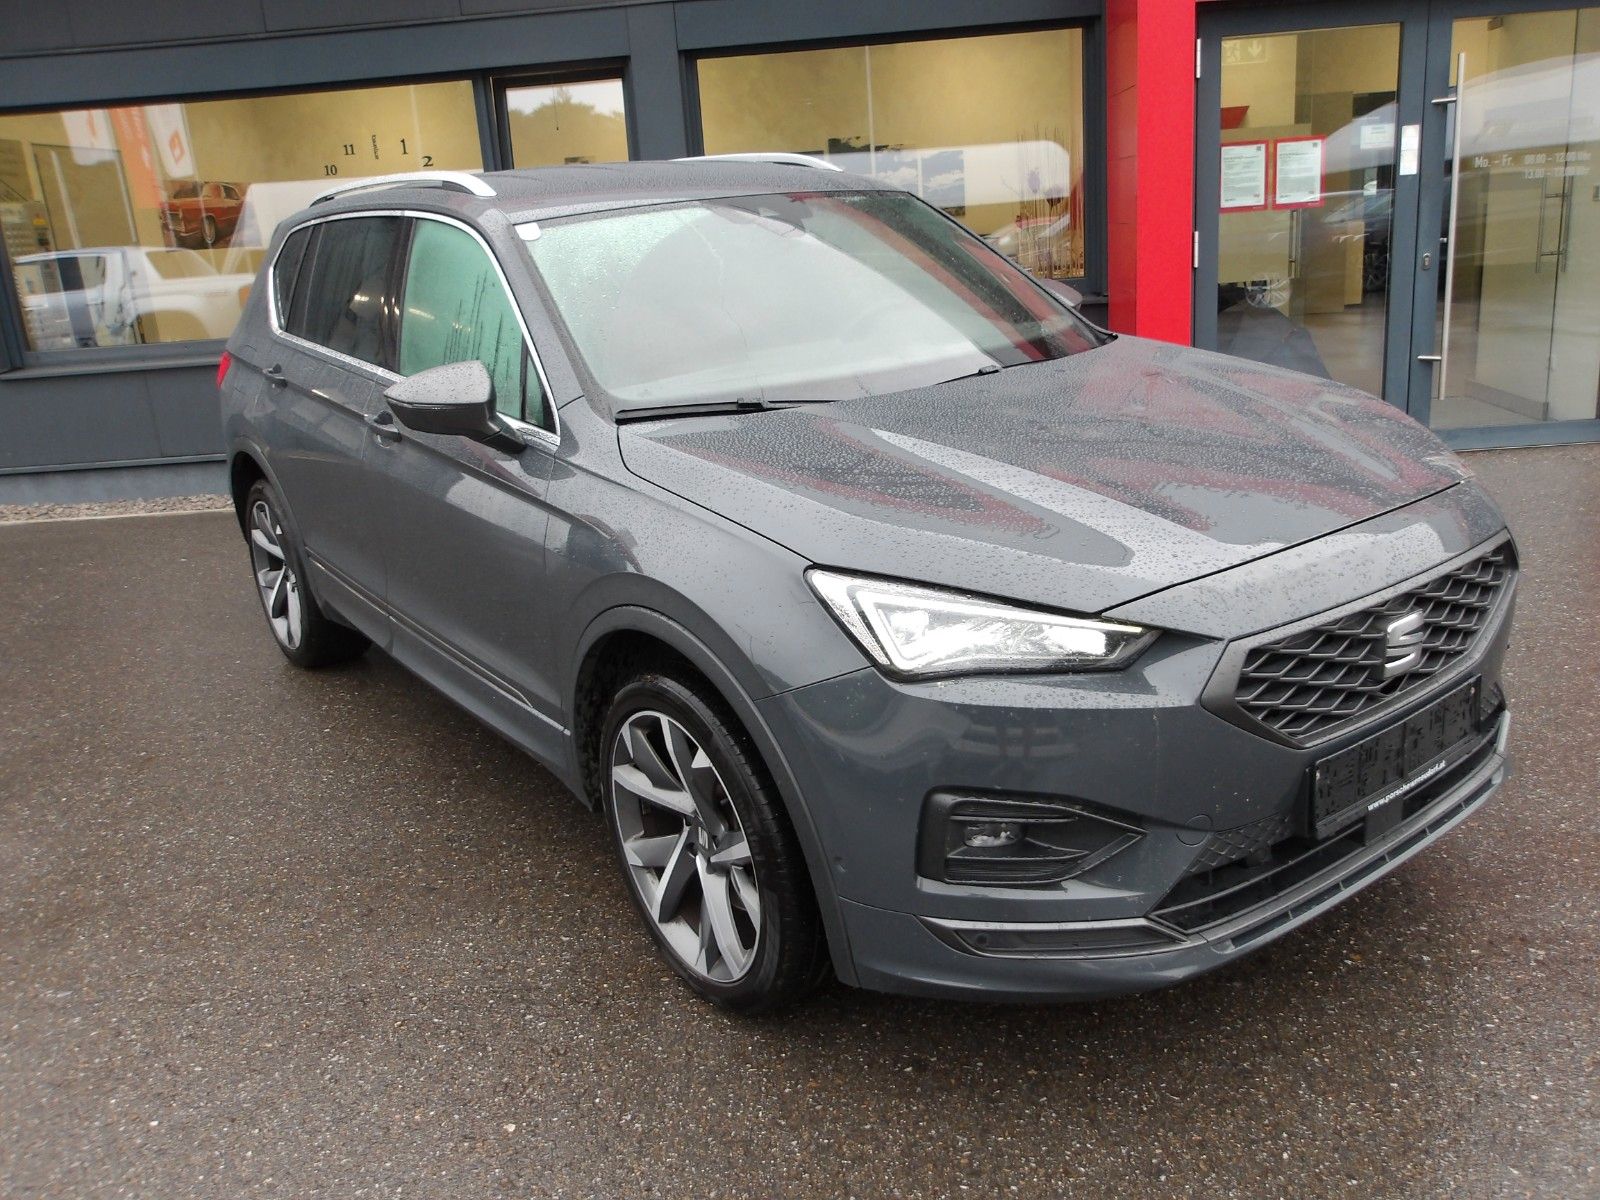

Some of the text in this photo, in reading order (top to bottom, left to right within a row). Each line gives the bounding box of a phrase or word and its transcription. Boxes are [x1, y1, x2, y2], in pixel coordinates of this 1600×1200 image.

[343, 144, 355, 156] 11
[400, 138, 408, 155] 1
[422, 155, 433, 167] 2
[324, 165, 337, 176] 10
